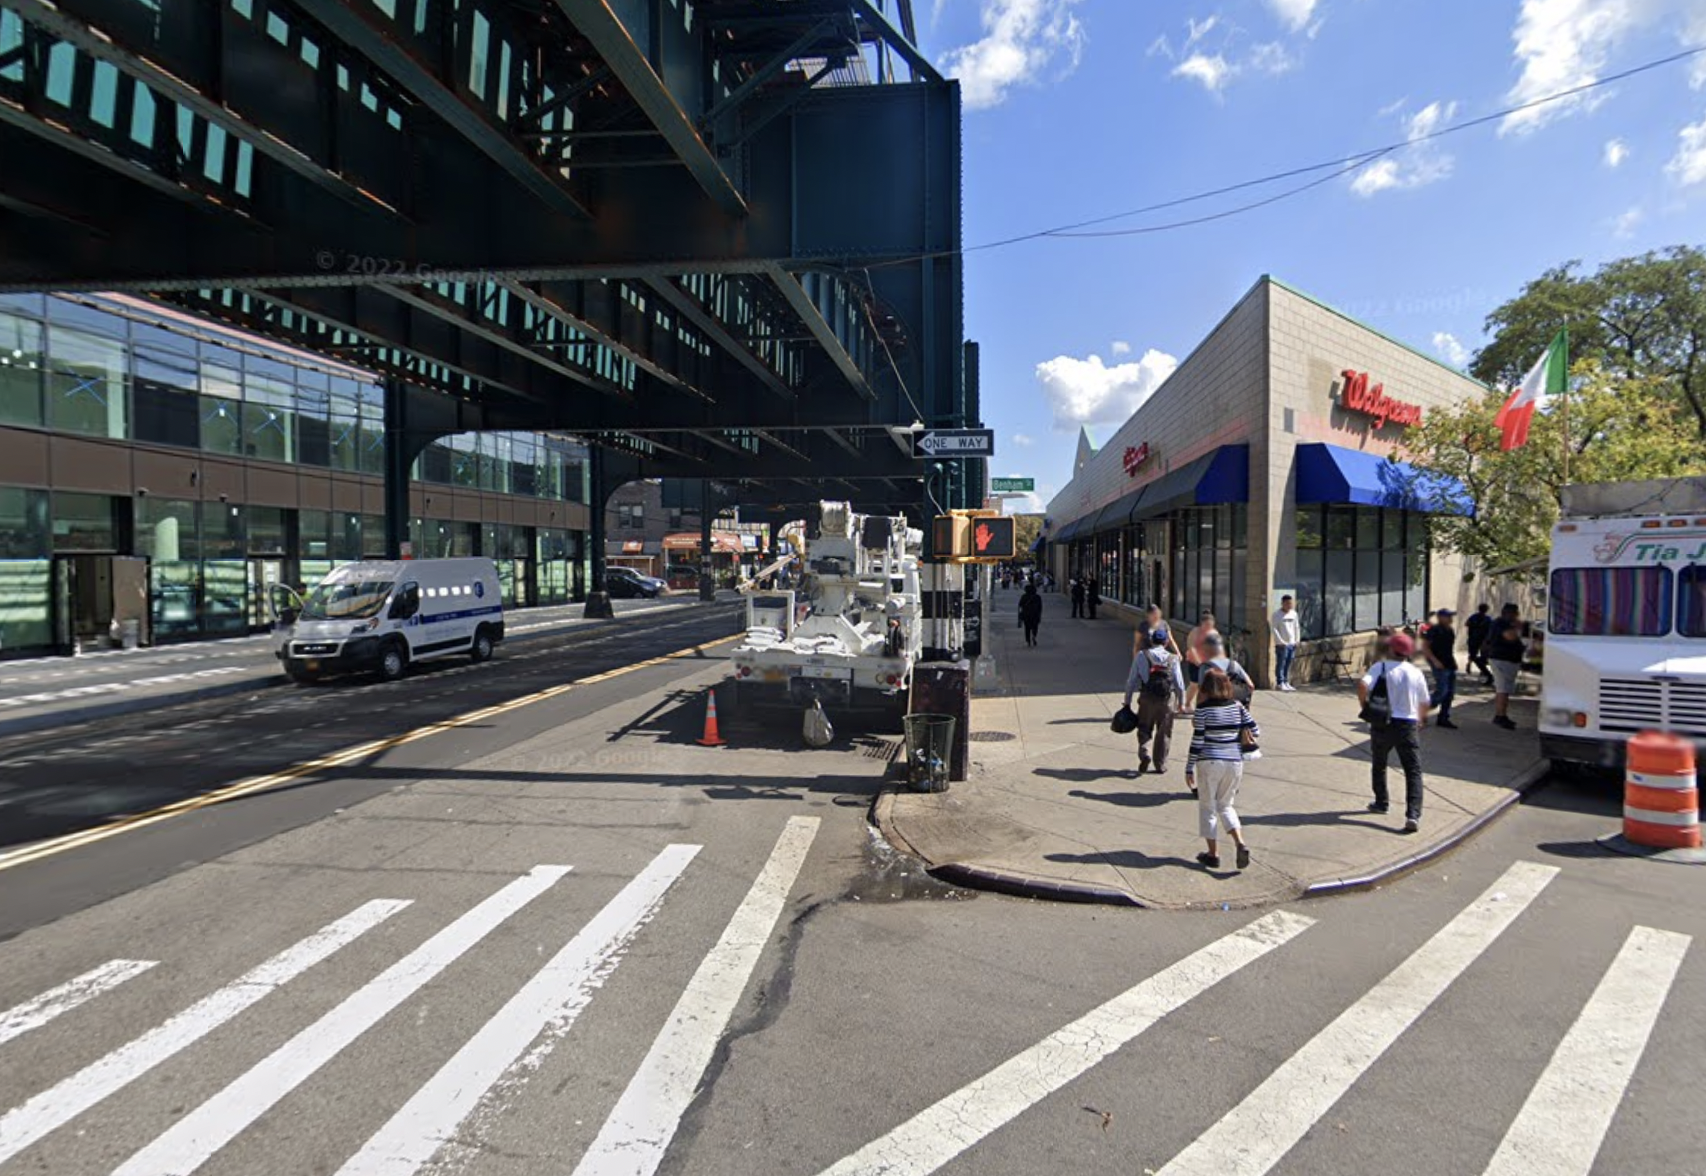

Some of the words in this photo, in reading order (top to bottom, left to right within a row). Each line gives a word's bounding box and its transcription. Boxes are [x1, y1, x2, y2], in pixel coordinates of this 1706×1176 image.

[1341, 369, 1421, 429] Walgreens
[925, 437, 948, 449] ONE
[958, 437, 983, 449] WAY
[1635, 544, 1679, 561] Tia
